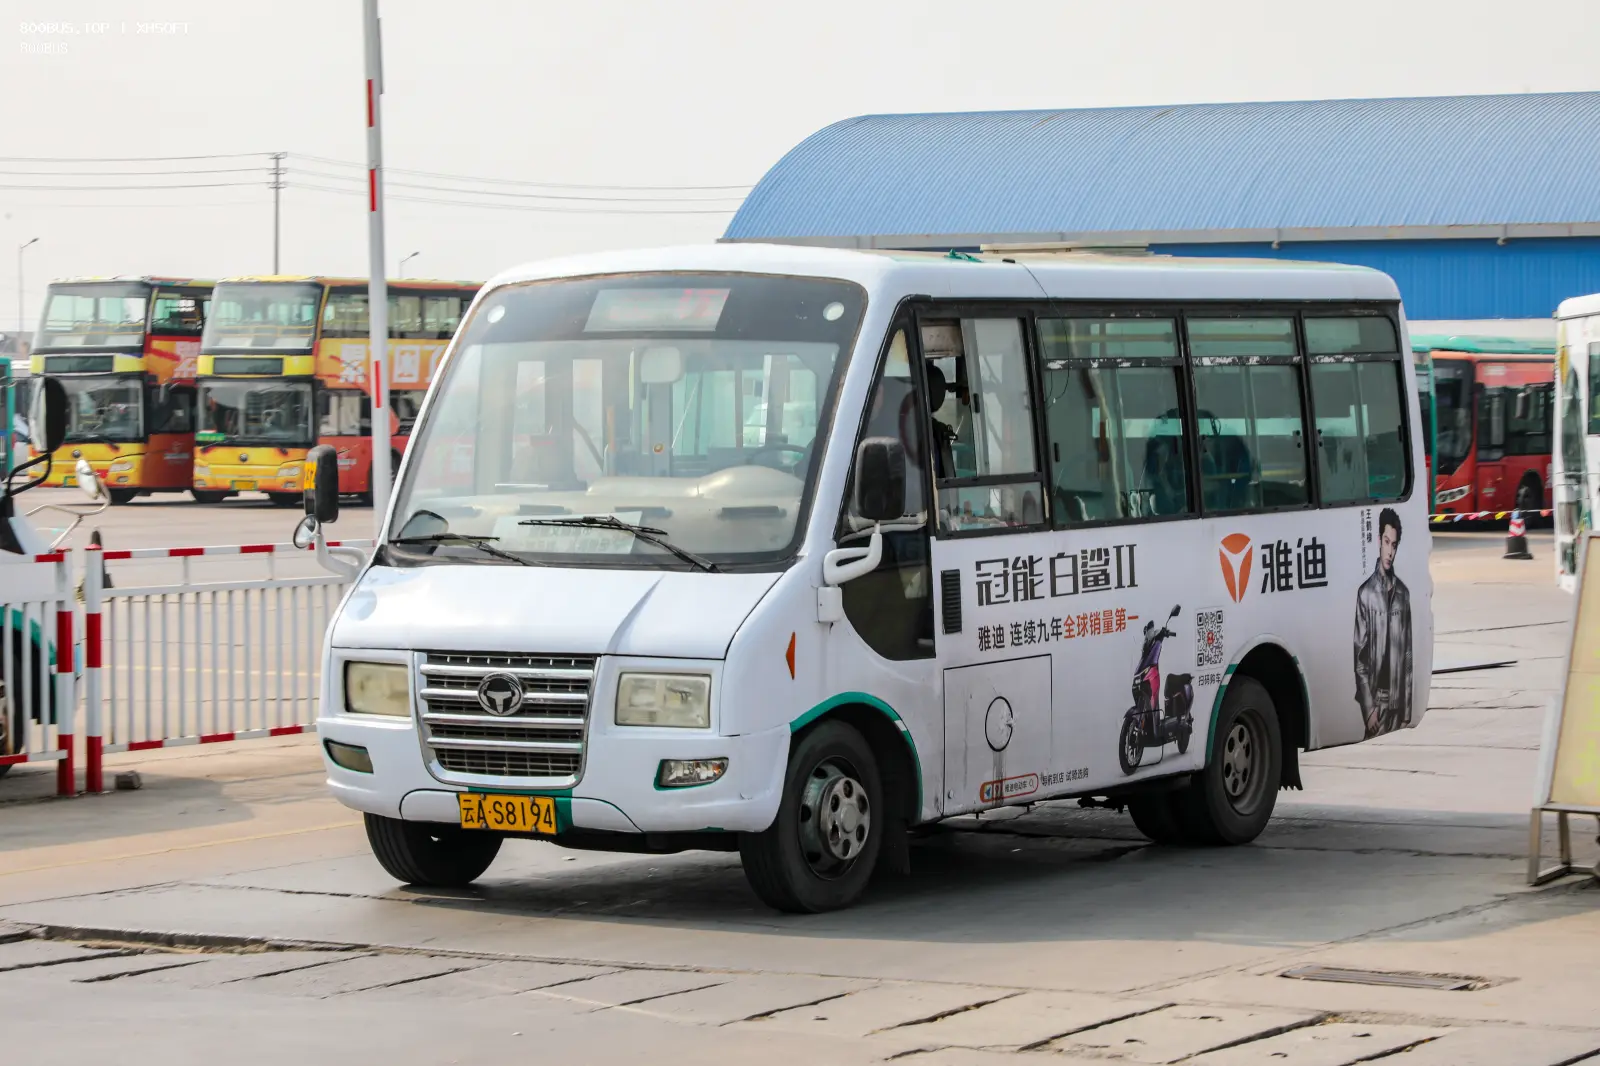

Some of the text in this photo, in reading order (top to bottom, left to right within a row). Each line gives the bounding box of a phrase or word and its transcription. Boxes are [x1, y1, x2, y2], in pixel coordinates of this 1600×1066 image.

[1261, 536, 1329, 594] 雅迪
[978, 607, 1140, 652] 雅迪 连续九年全球销量第一
[1198, 673, 1222, 687] 扫码购车
